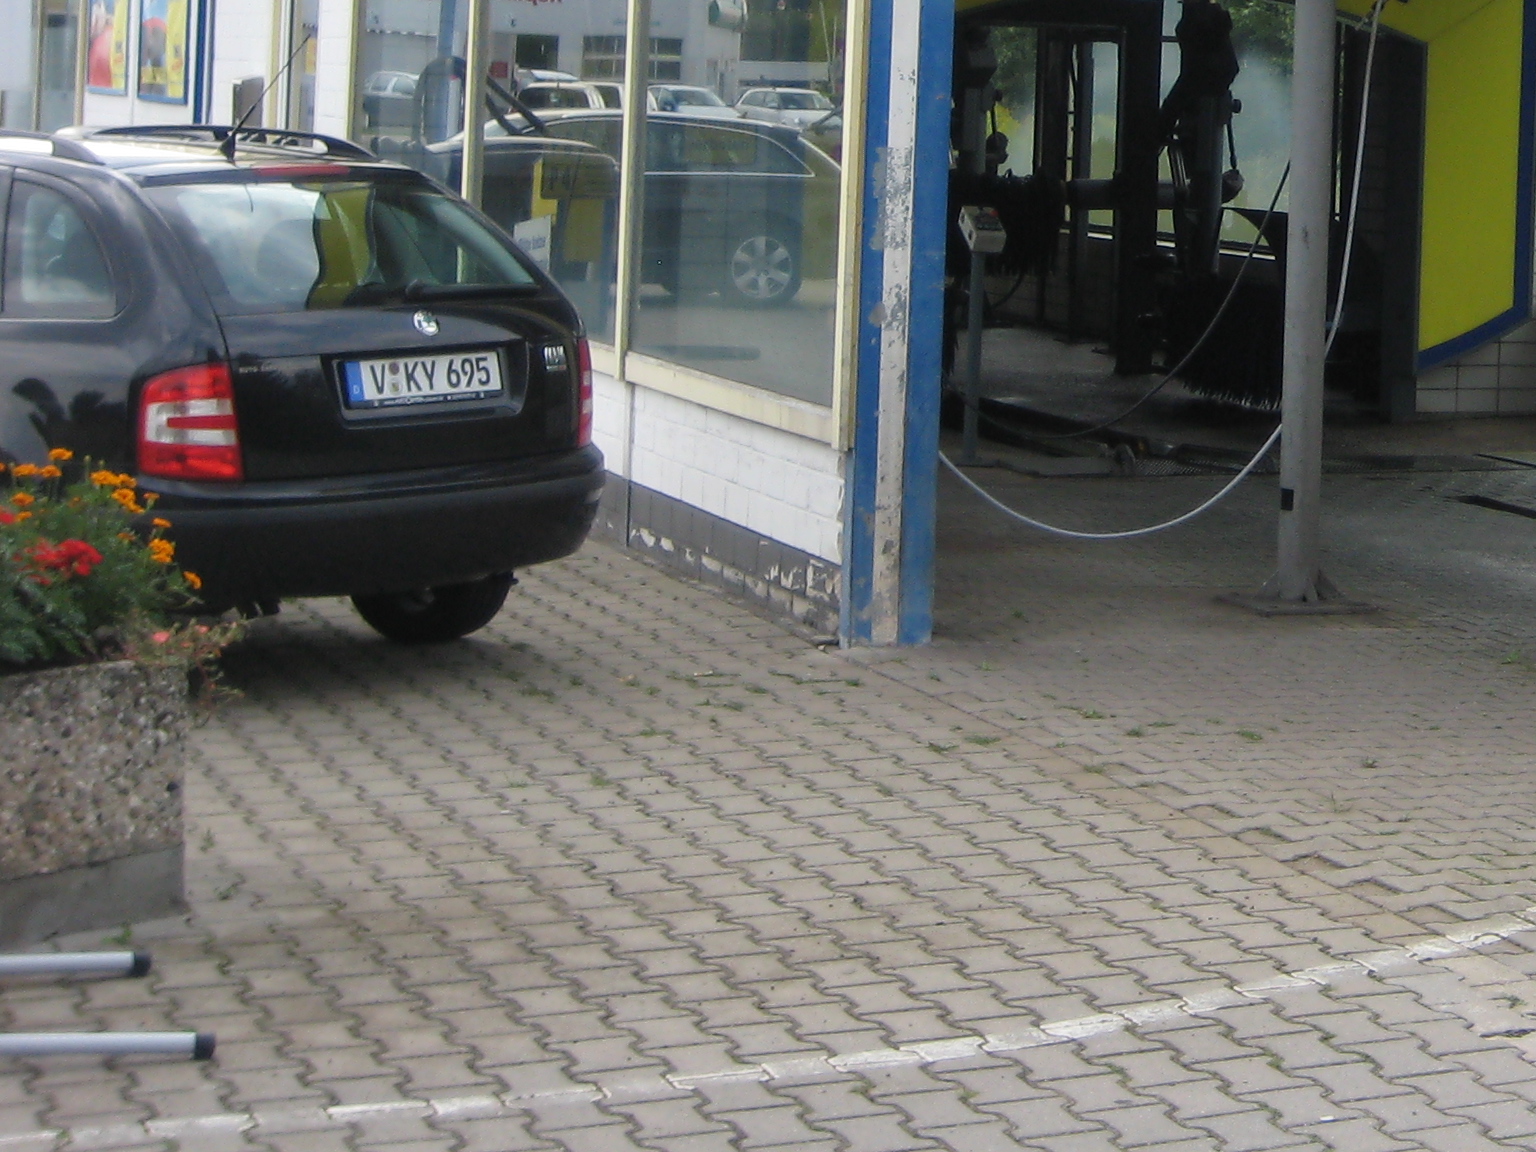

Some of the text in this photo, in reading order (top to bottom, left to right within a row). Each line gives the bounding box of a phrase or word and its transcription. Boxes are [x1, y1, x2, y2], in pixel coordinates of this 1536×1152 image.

[369, 356, 491, 395] V KY 695
